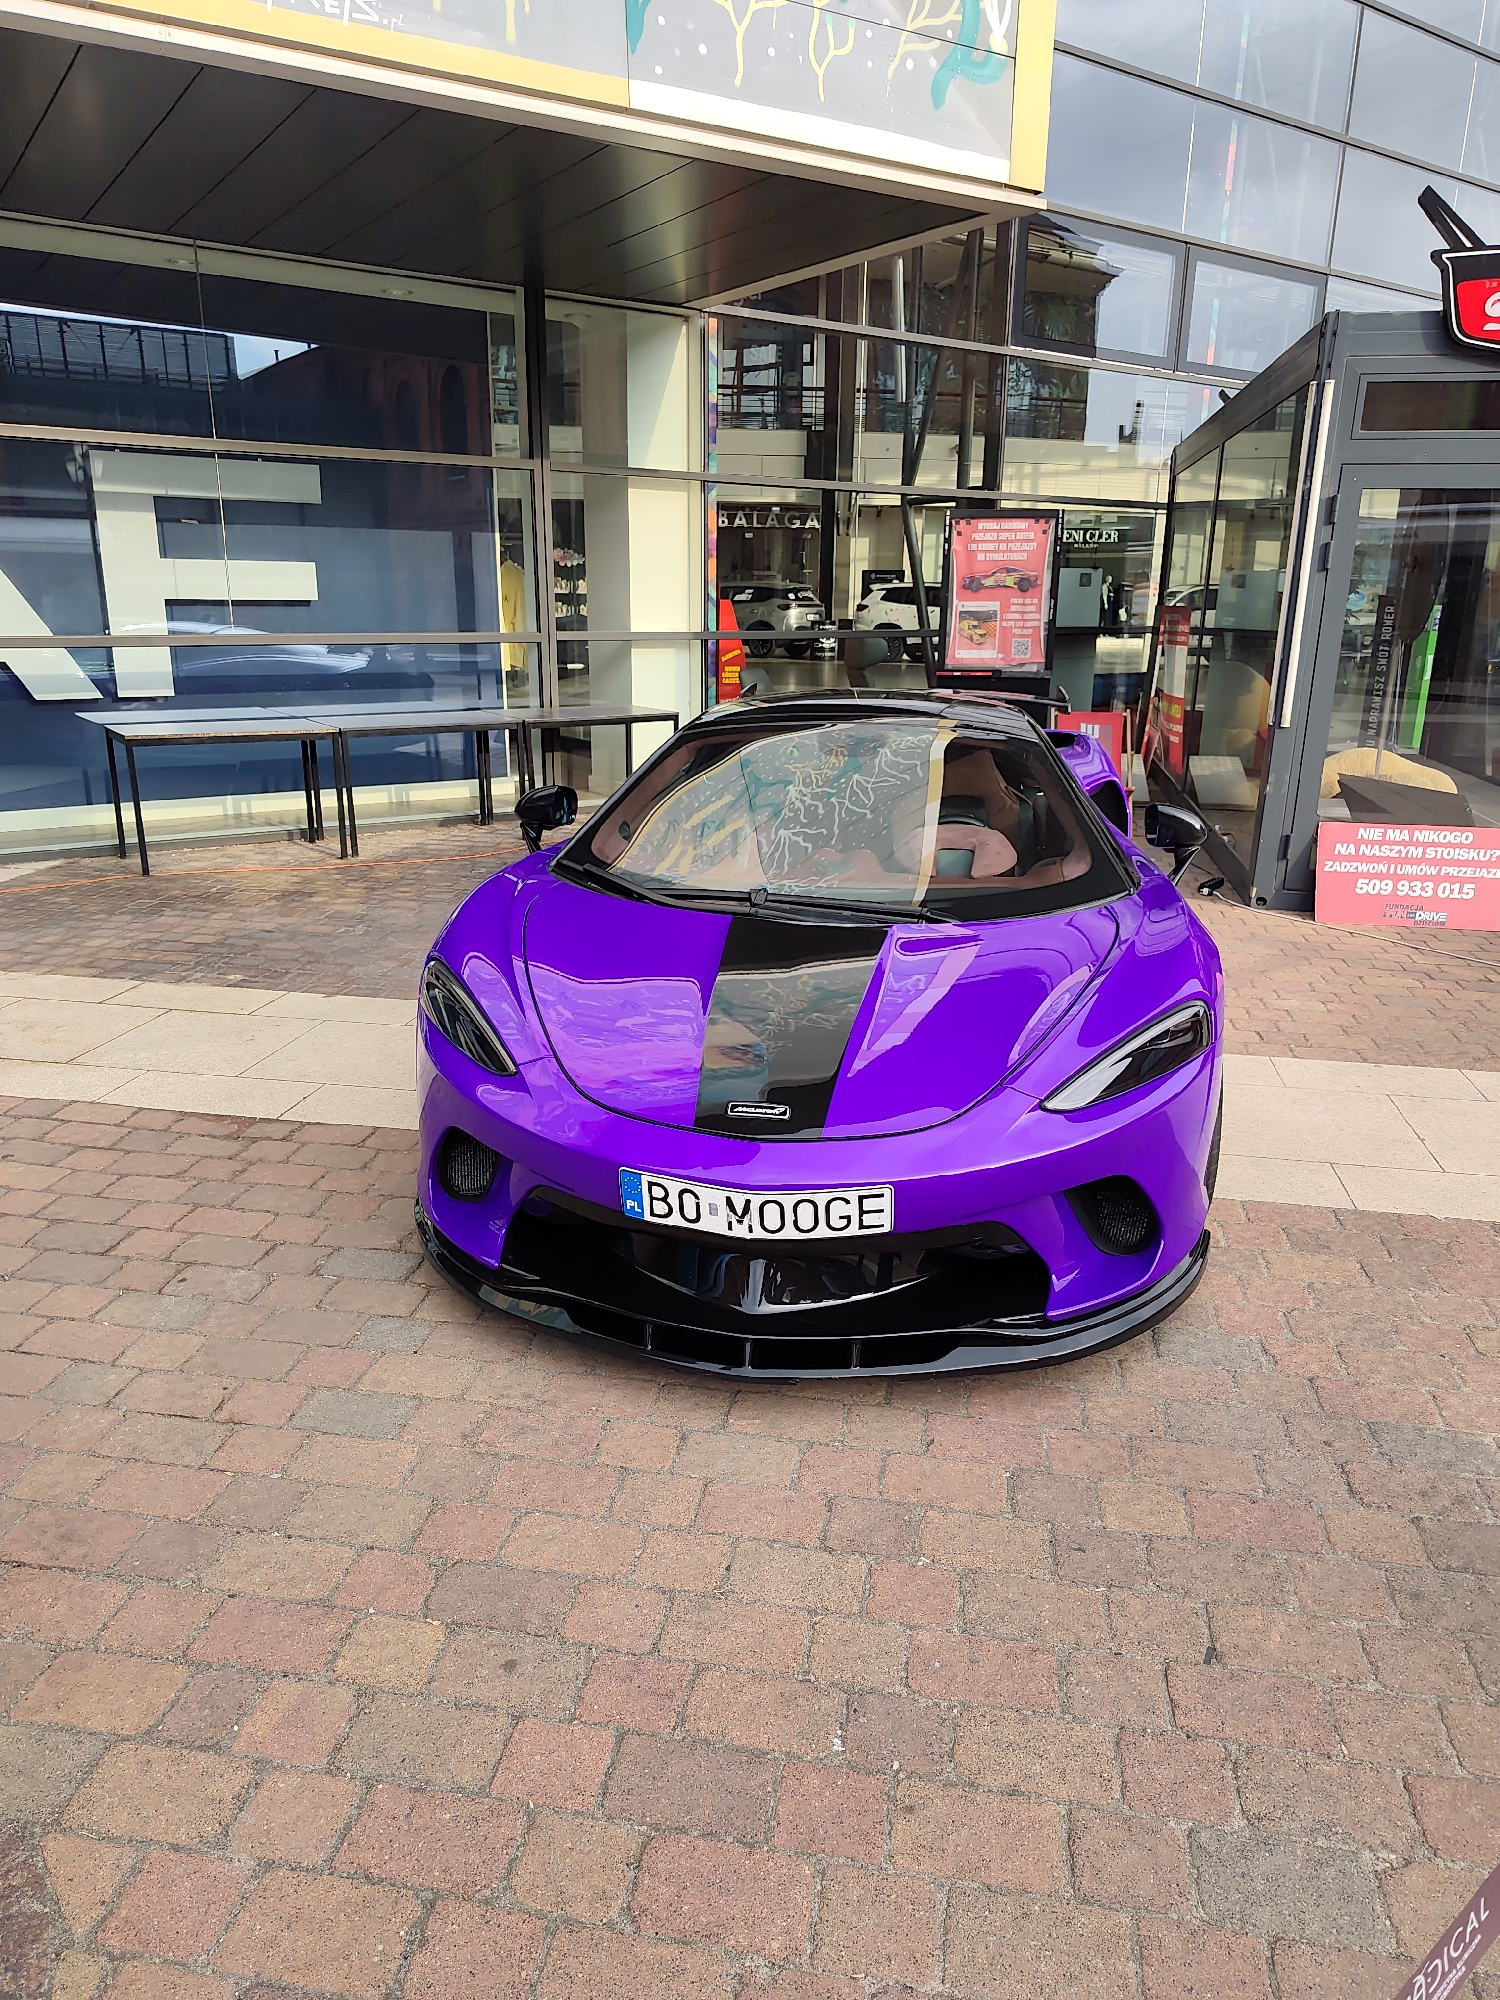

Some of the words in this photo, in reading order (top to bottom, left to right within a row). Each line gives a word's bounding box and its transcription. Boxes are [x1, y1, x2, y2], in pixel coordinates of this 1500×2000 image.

[718, 510, 821, 529] BALAGA
[1062, 530, 1084, 543] ENI
[1086, 530, 1119, 543] CLER
[1380, 605, 1395, 640] ROWER
[1366, 675, 1386, 737] NAPRAWISZ
[1365, 739, 1376, 748] U
[1357, 827, 1385, 841] NIE
[1385, 828, 1410, 842] MA
[1412, 829, 1474, 844] NIKOGO
[1334, 843, 1356, 856] NA
[1358, 843, 1423, 859] NASZYM
[1424, 846, 1500, 862] STOISKU?
[1323, 860, 1388, 875] ZADZWOŃ
[1389, 864, 1396, 875] I
[1396, 862, 1439, 876] UMÓW
[1354, 878, 1394, 896] 509
[1396, 880, 1434, 898] 933
[1436, 882, 1476, 900] 015
[1384, 903, 1424, 911] FUNDACJA
[1415, 911, 1448, 922] DRIVE
[626, 1199, 643, 1213] PL
[1407, 1896, 1490, 2000] ADICAL
